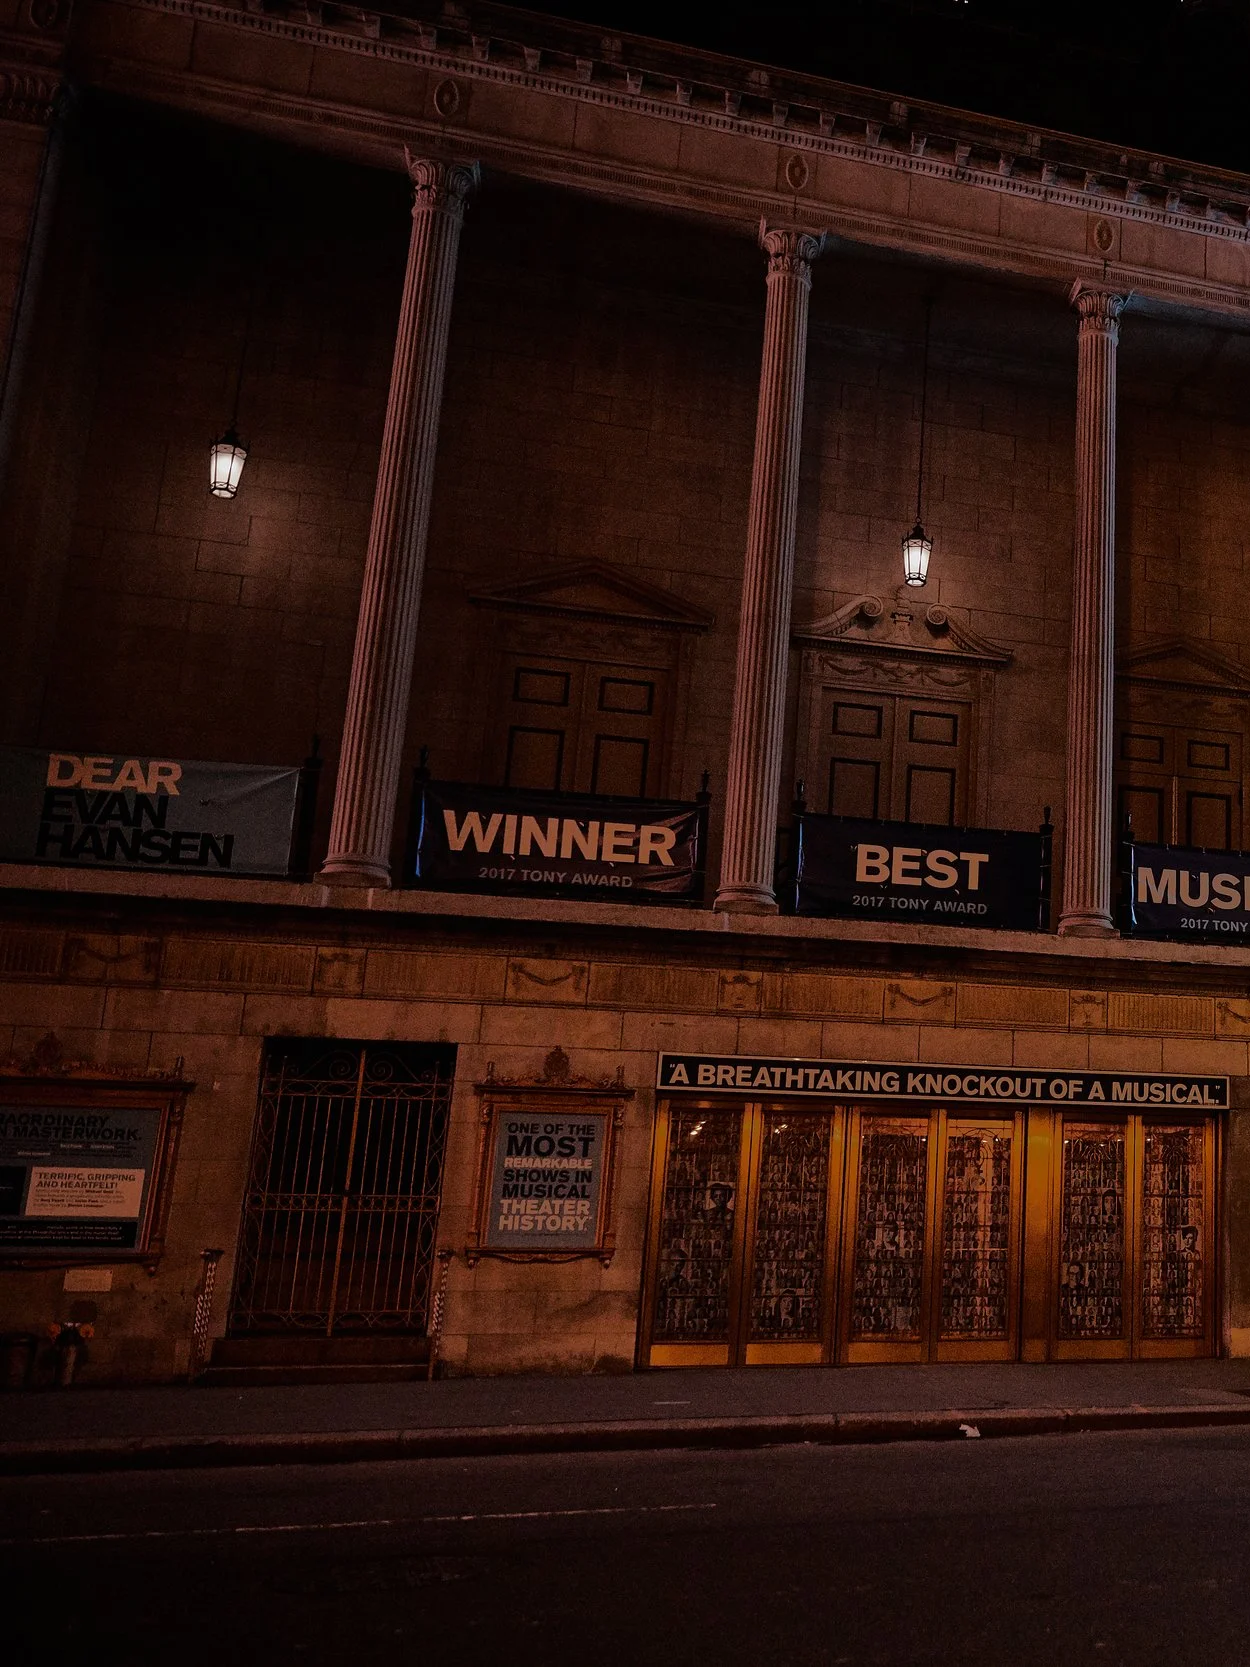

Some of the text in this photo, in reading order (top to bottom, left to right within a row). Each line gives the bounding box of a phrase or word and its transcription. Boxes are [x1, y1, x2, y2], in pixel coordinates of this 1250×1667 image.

[47, 752, 183, 796] DEAR
[41, 788, 170, 828] EVAN
[35, 822, 234, 868] HANSEN
[442, 808, 677, 866] WINNER
[478, 867, 633, 888] 2017 TONY AWARD
[855, 843, 990, 891] BEST
[852, 894, 988, 915] 2017 TONY AWARD
[1180, 917, 1209, 930] 2017
[1212, 919, 1248, 935] TONY
[697, 1064, 899, 1093] BREATHTAKING
[907, 1072, 1046, 1098] KNOCKOUT
[1049, 1079, 1083, 1100] OF
[1088, 1080, 1105, 1100] A
[543, 1123, 563, 1134] OF
[568, 1124, 595, 1135] THE
[506, 1135, 595, 1157] MOST
[503, 1157, 592, 1169] REMARKABLE
[35, 1180, 118, 1189] AND HEARTFELT!
[87, 1173, 136, 1182] GRIPPING
[503, 1169, 592, 1183] SHOWS IN
[501, 1183, 590, 1199] MUSICAL
[500, 1199, 591, 1216] THEATER
